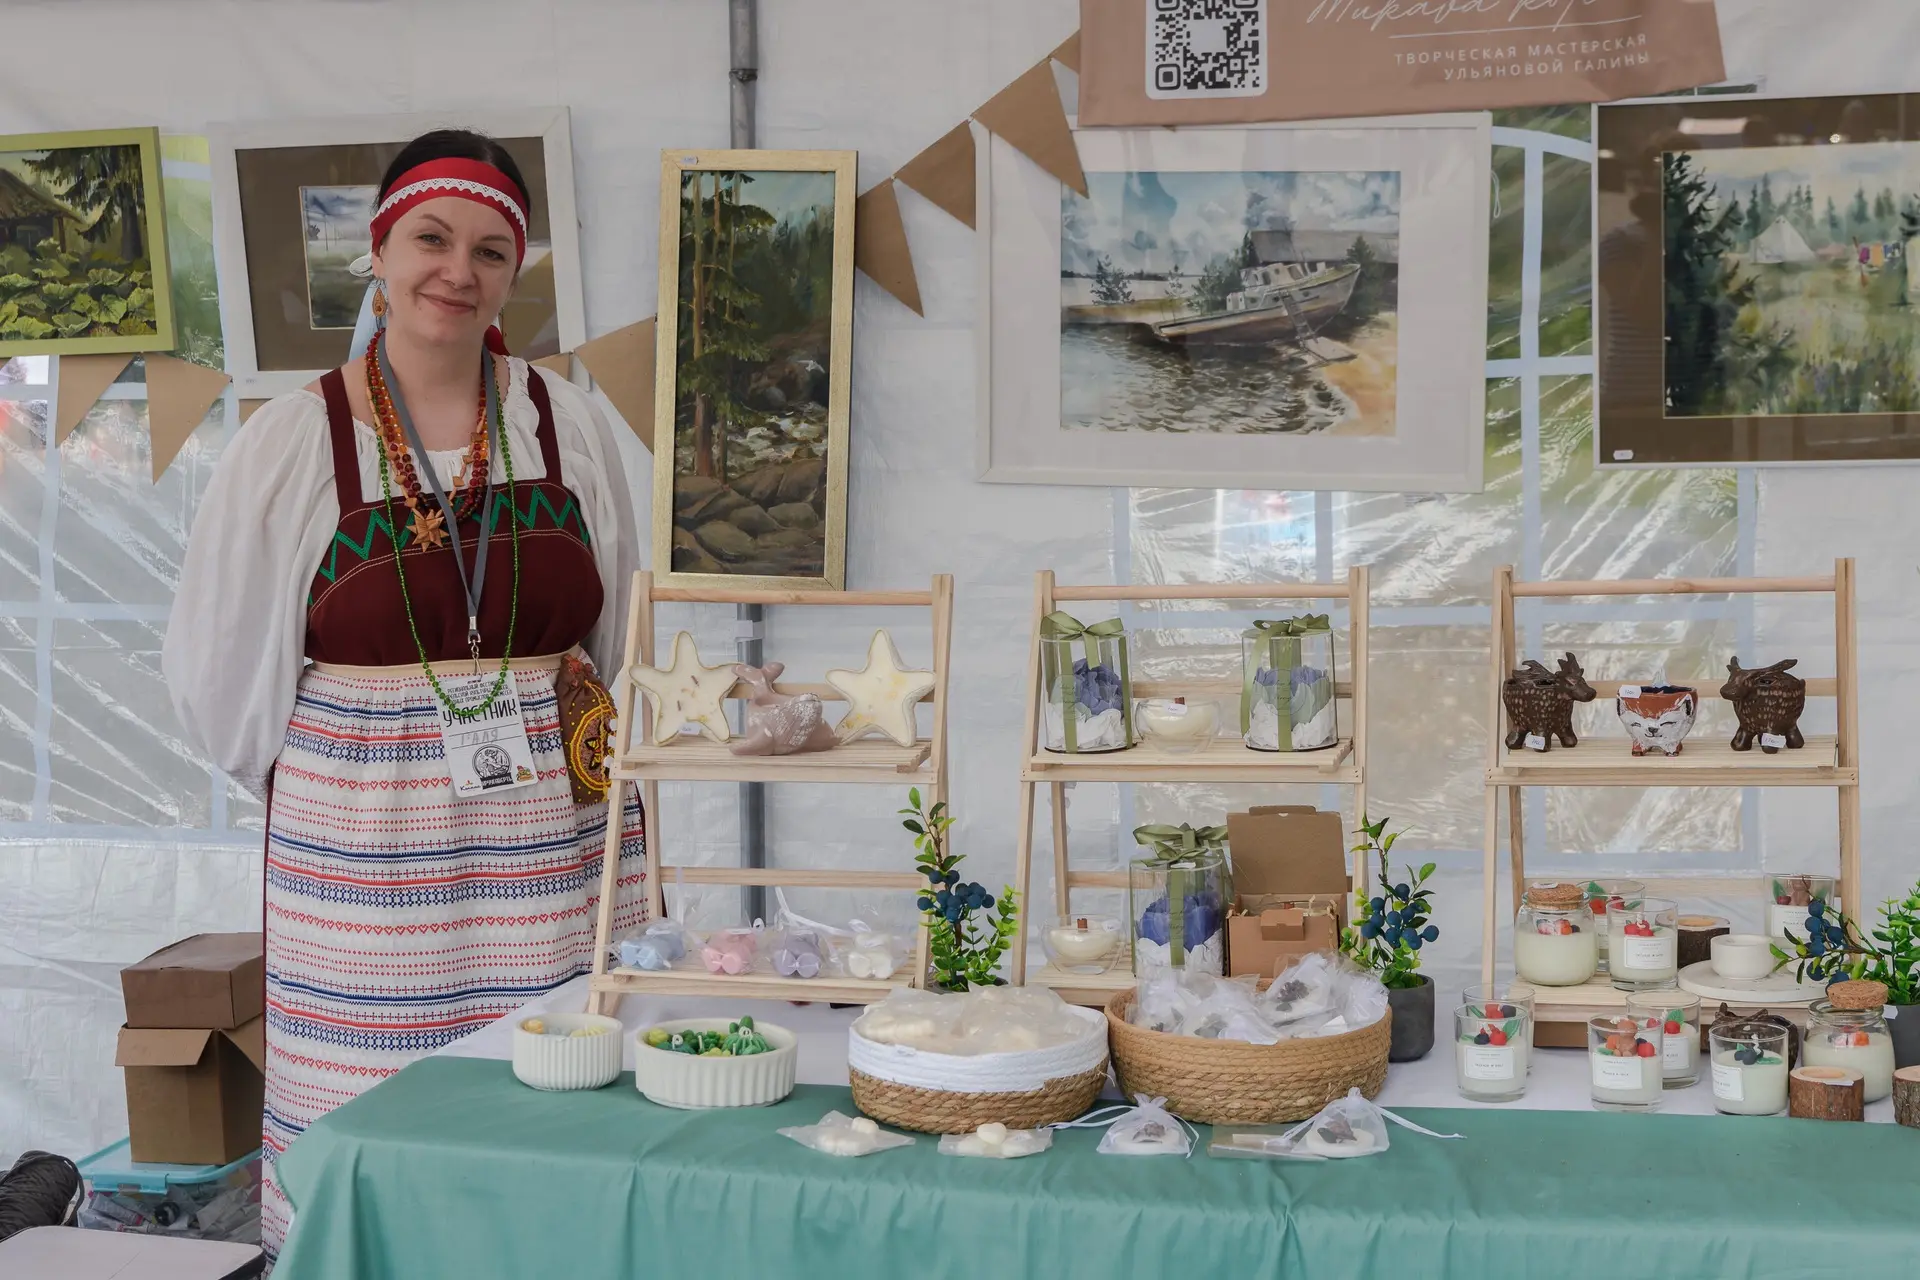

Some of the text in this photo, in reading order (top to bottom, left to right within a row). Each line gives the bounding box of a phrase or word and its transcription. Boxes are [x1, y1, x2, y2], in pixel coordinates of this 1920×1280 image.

[1394, 33, 1647, 66] ТВОРЧЕСКАЯ МАСТЕРСКАЯ
[1443, 52, 1649, 81] УЛЬЯНОВОЙ ГАЛИНЫ
